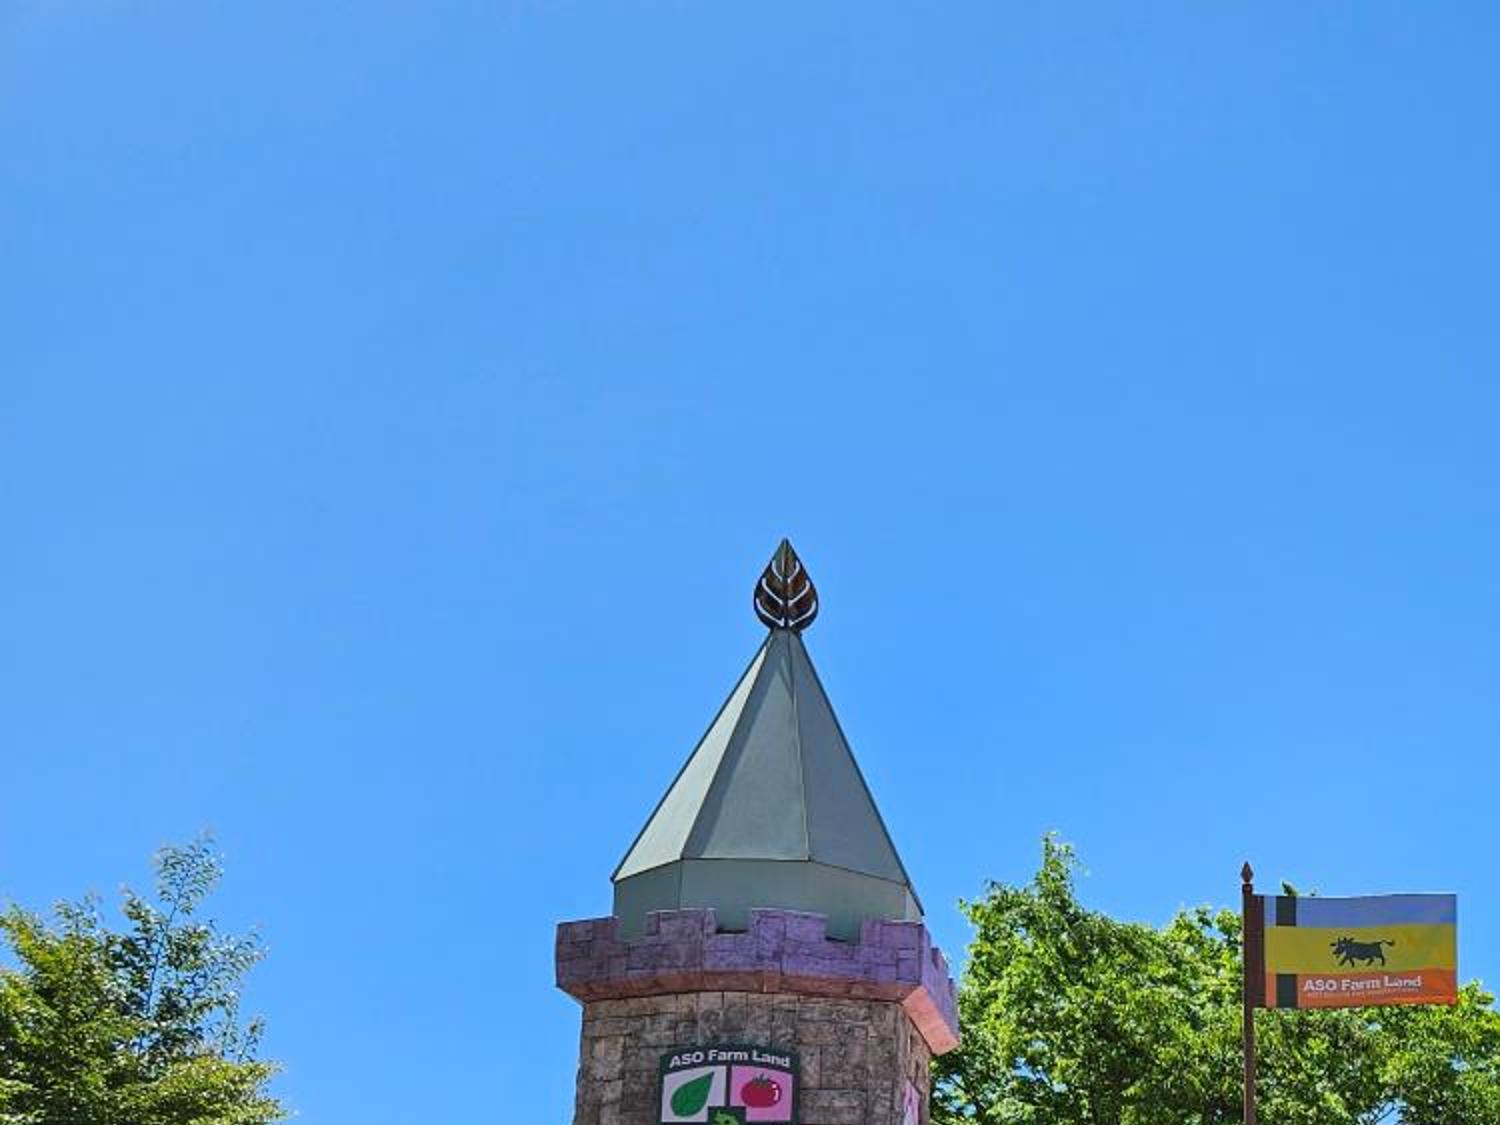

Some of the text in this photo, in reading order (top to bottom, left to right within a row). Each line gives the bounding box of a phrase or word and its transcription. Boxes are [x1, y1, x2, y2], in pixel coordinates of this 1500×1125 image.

[1303, 975, 1422, 992] ASO Farm Land
[669, 1049, 791, 1069] ASO Farm Land
